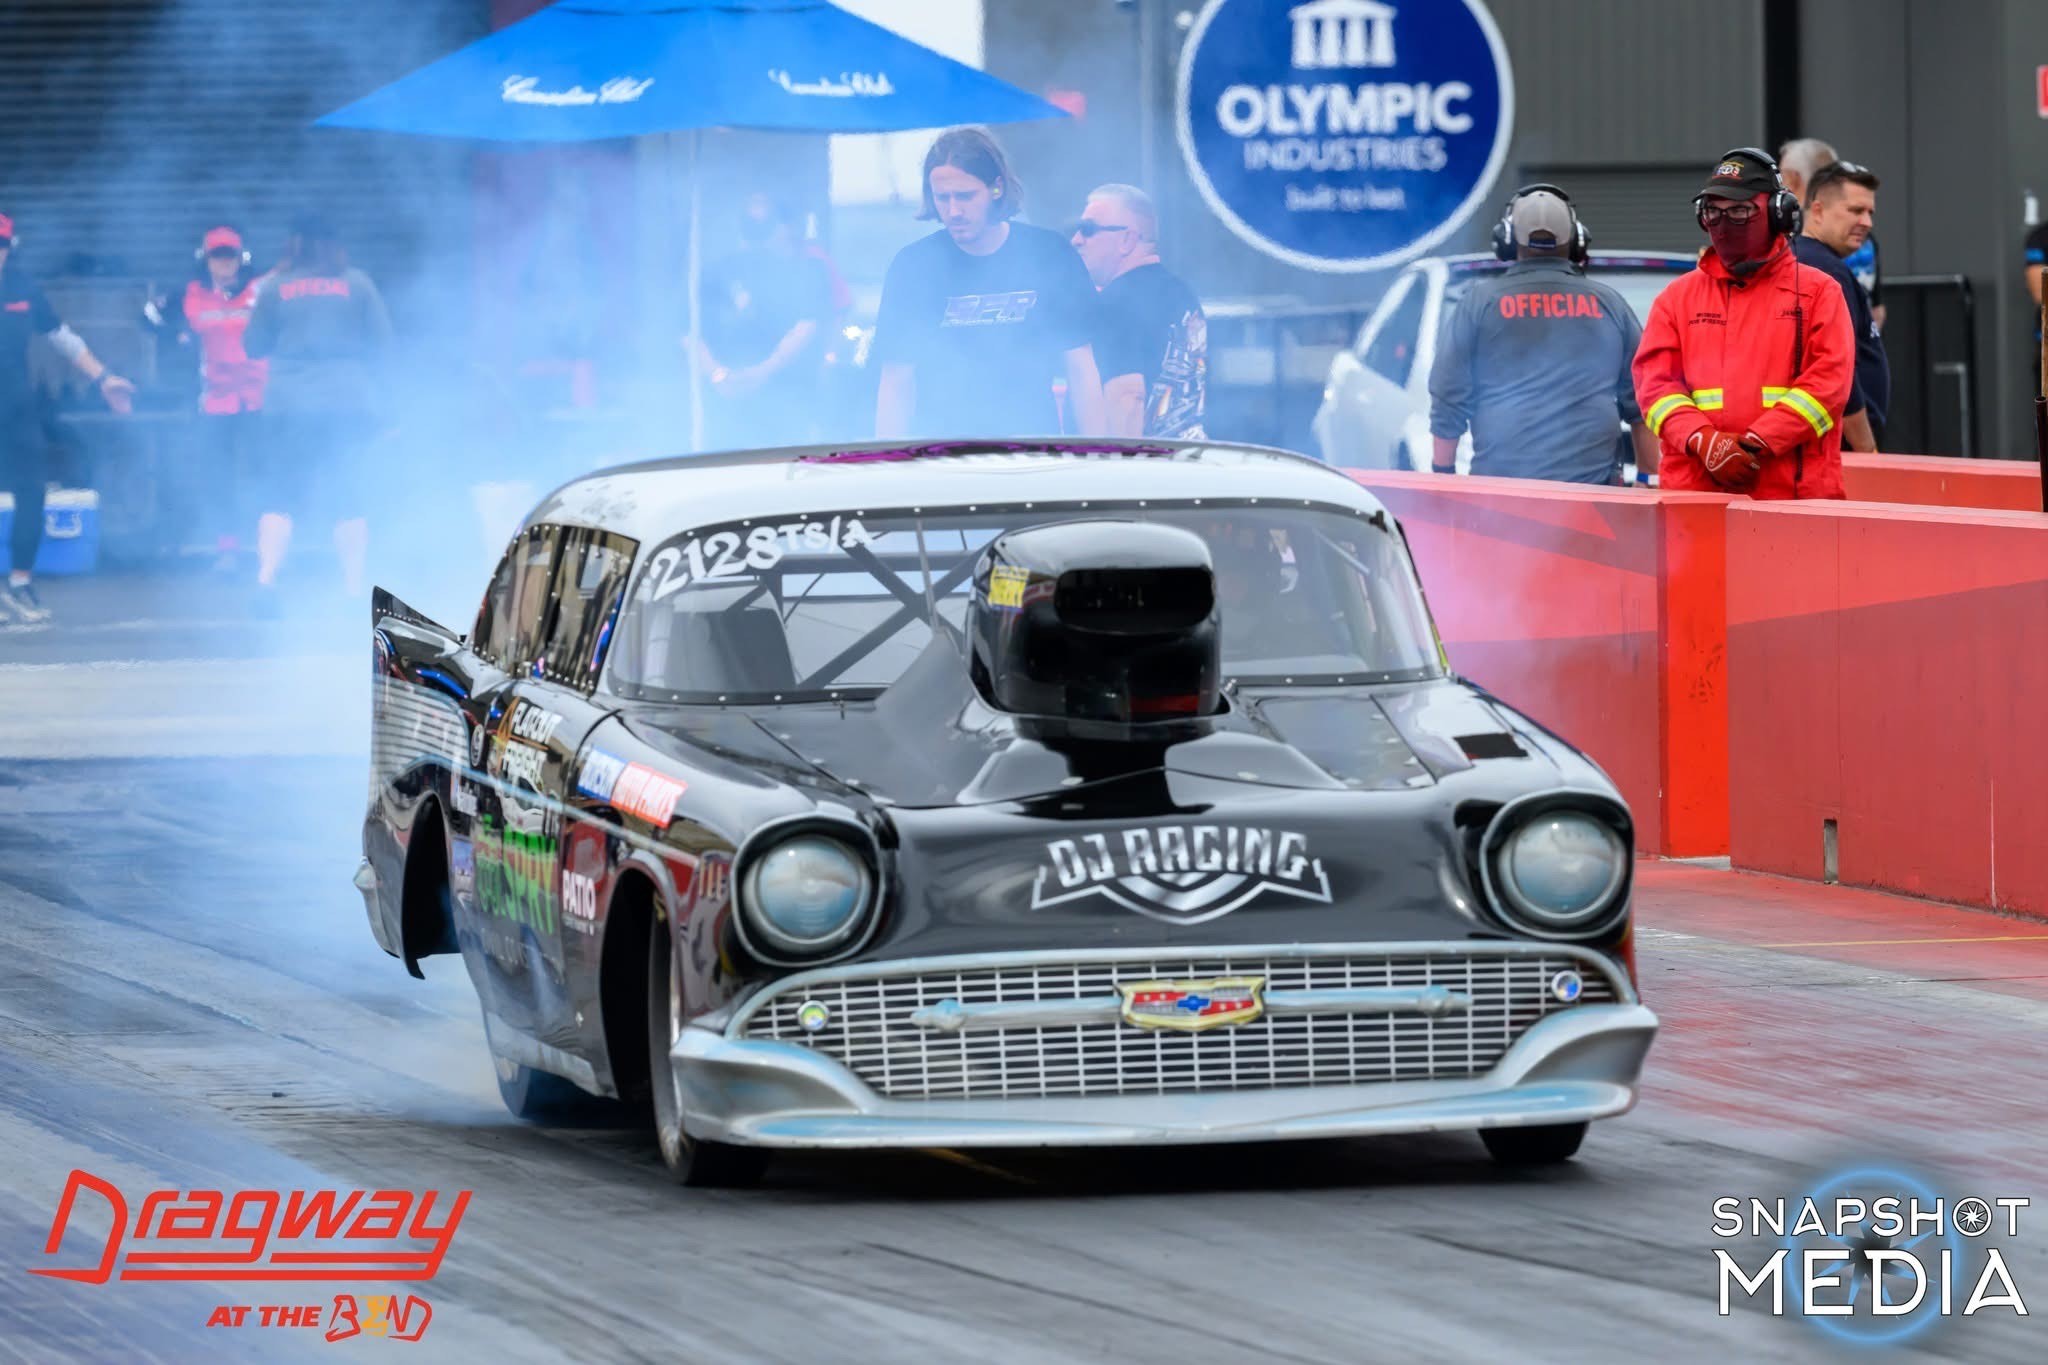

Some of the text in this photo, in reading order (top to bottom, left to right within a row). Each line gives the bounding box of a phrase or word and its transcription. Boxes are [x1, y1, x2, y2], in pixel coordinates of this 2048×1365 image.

[1216, 81, 1473, 137] OLYMPIC
[1244, 136, 1448, 172] INDUSTRIES
[1500, 292, 1604, 319] OFFICIAL
[1047, 825, 1309, 888] DJ RACING
[563, 869, 596, 921] PATIO
